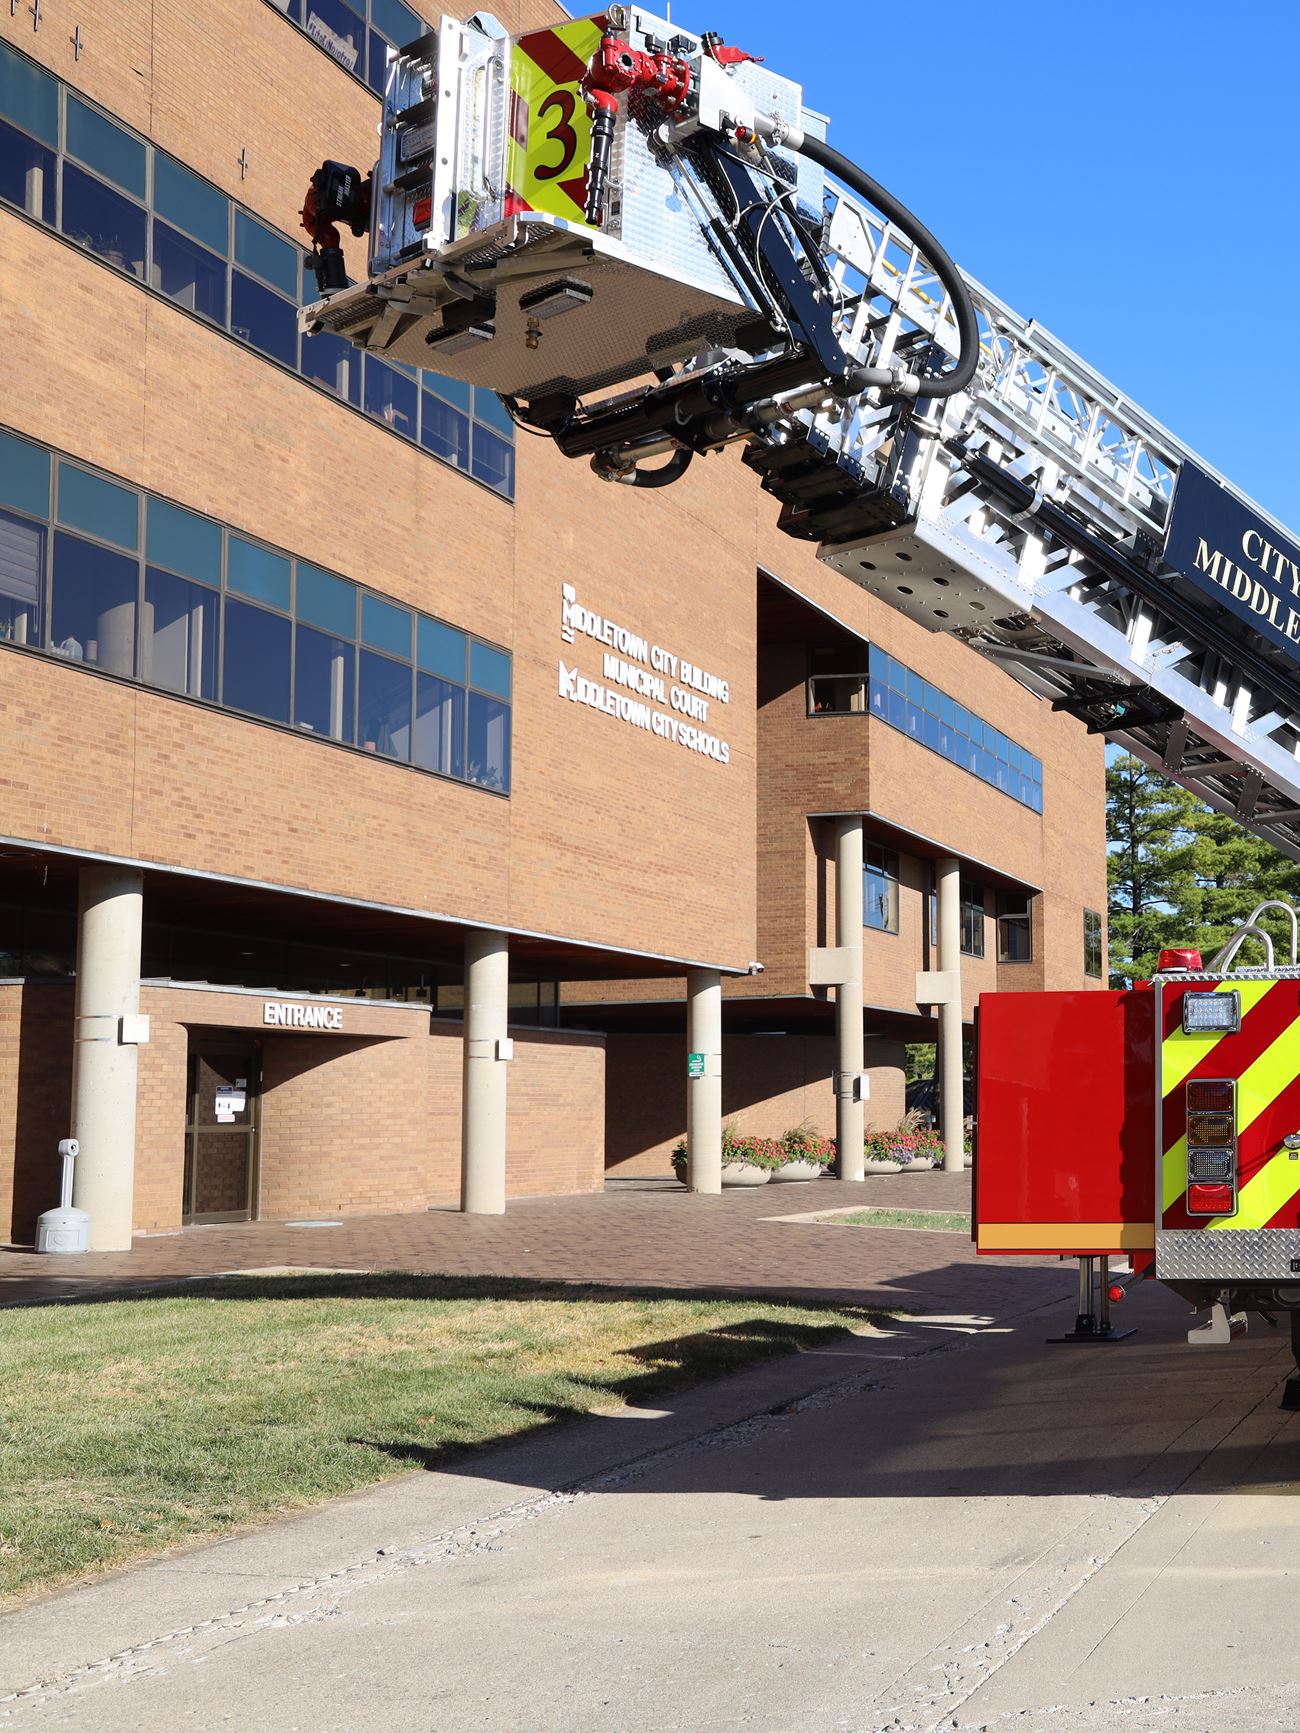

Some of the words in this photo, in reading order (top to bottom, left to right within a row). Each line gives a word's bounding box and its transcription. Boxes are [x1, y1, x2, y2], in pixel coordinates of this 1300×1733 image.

[533, 89, 577, 181] 3
[336, 185, 344, 207] STREAM
[344, 175, 352, 197] MASTER
[562, 598, 648, 664] MIDDLETOWN
[650, 645, 679, 678] CITY
[680, 659, 729, 704] BUILDING
[603, 653, 669, 705] MUNICIPAL
[669, 685, 709, 723] COURT
[651, 710, 679, 742] CITY
[678, 722, 730, 764] SCHOOLS
[263, 1001, 344, 1029] ENTRANCE
